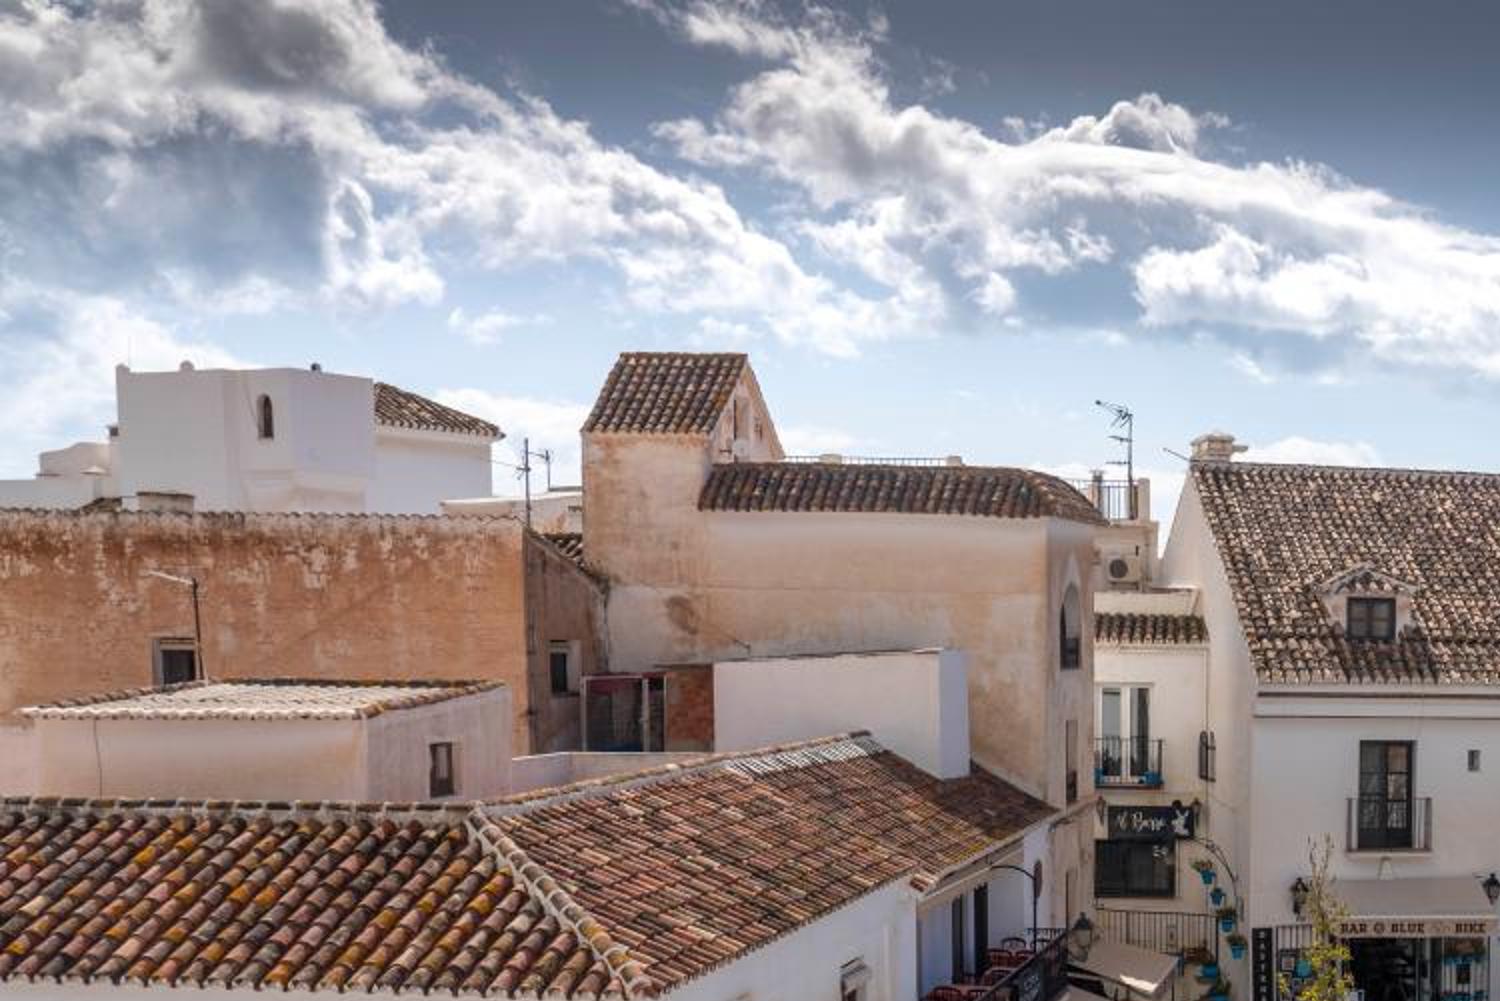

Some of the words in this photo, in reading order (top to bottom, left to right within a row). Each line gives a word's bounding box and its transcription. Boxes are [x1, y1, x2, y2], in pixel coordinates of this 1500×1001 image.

[1340, 922, 1367, 934] BAR
[1391, 922, 1425, 934] BLUE
[1455, 922, 1486, 934] BIKE
